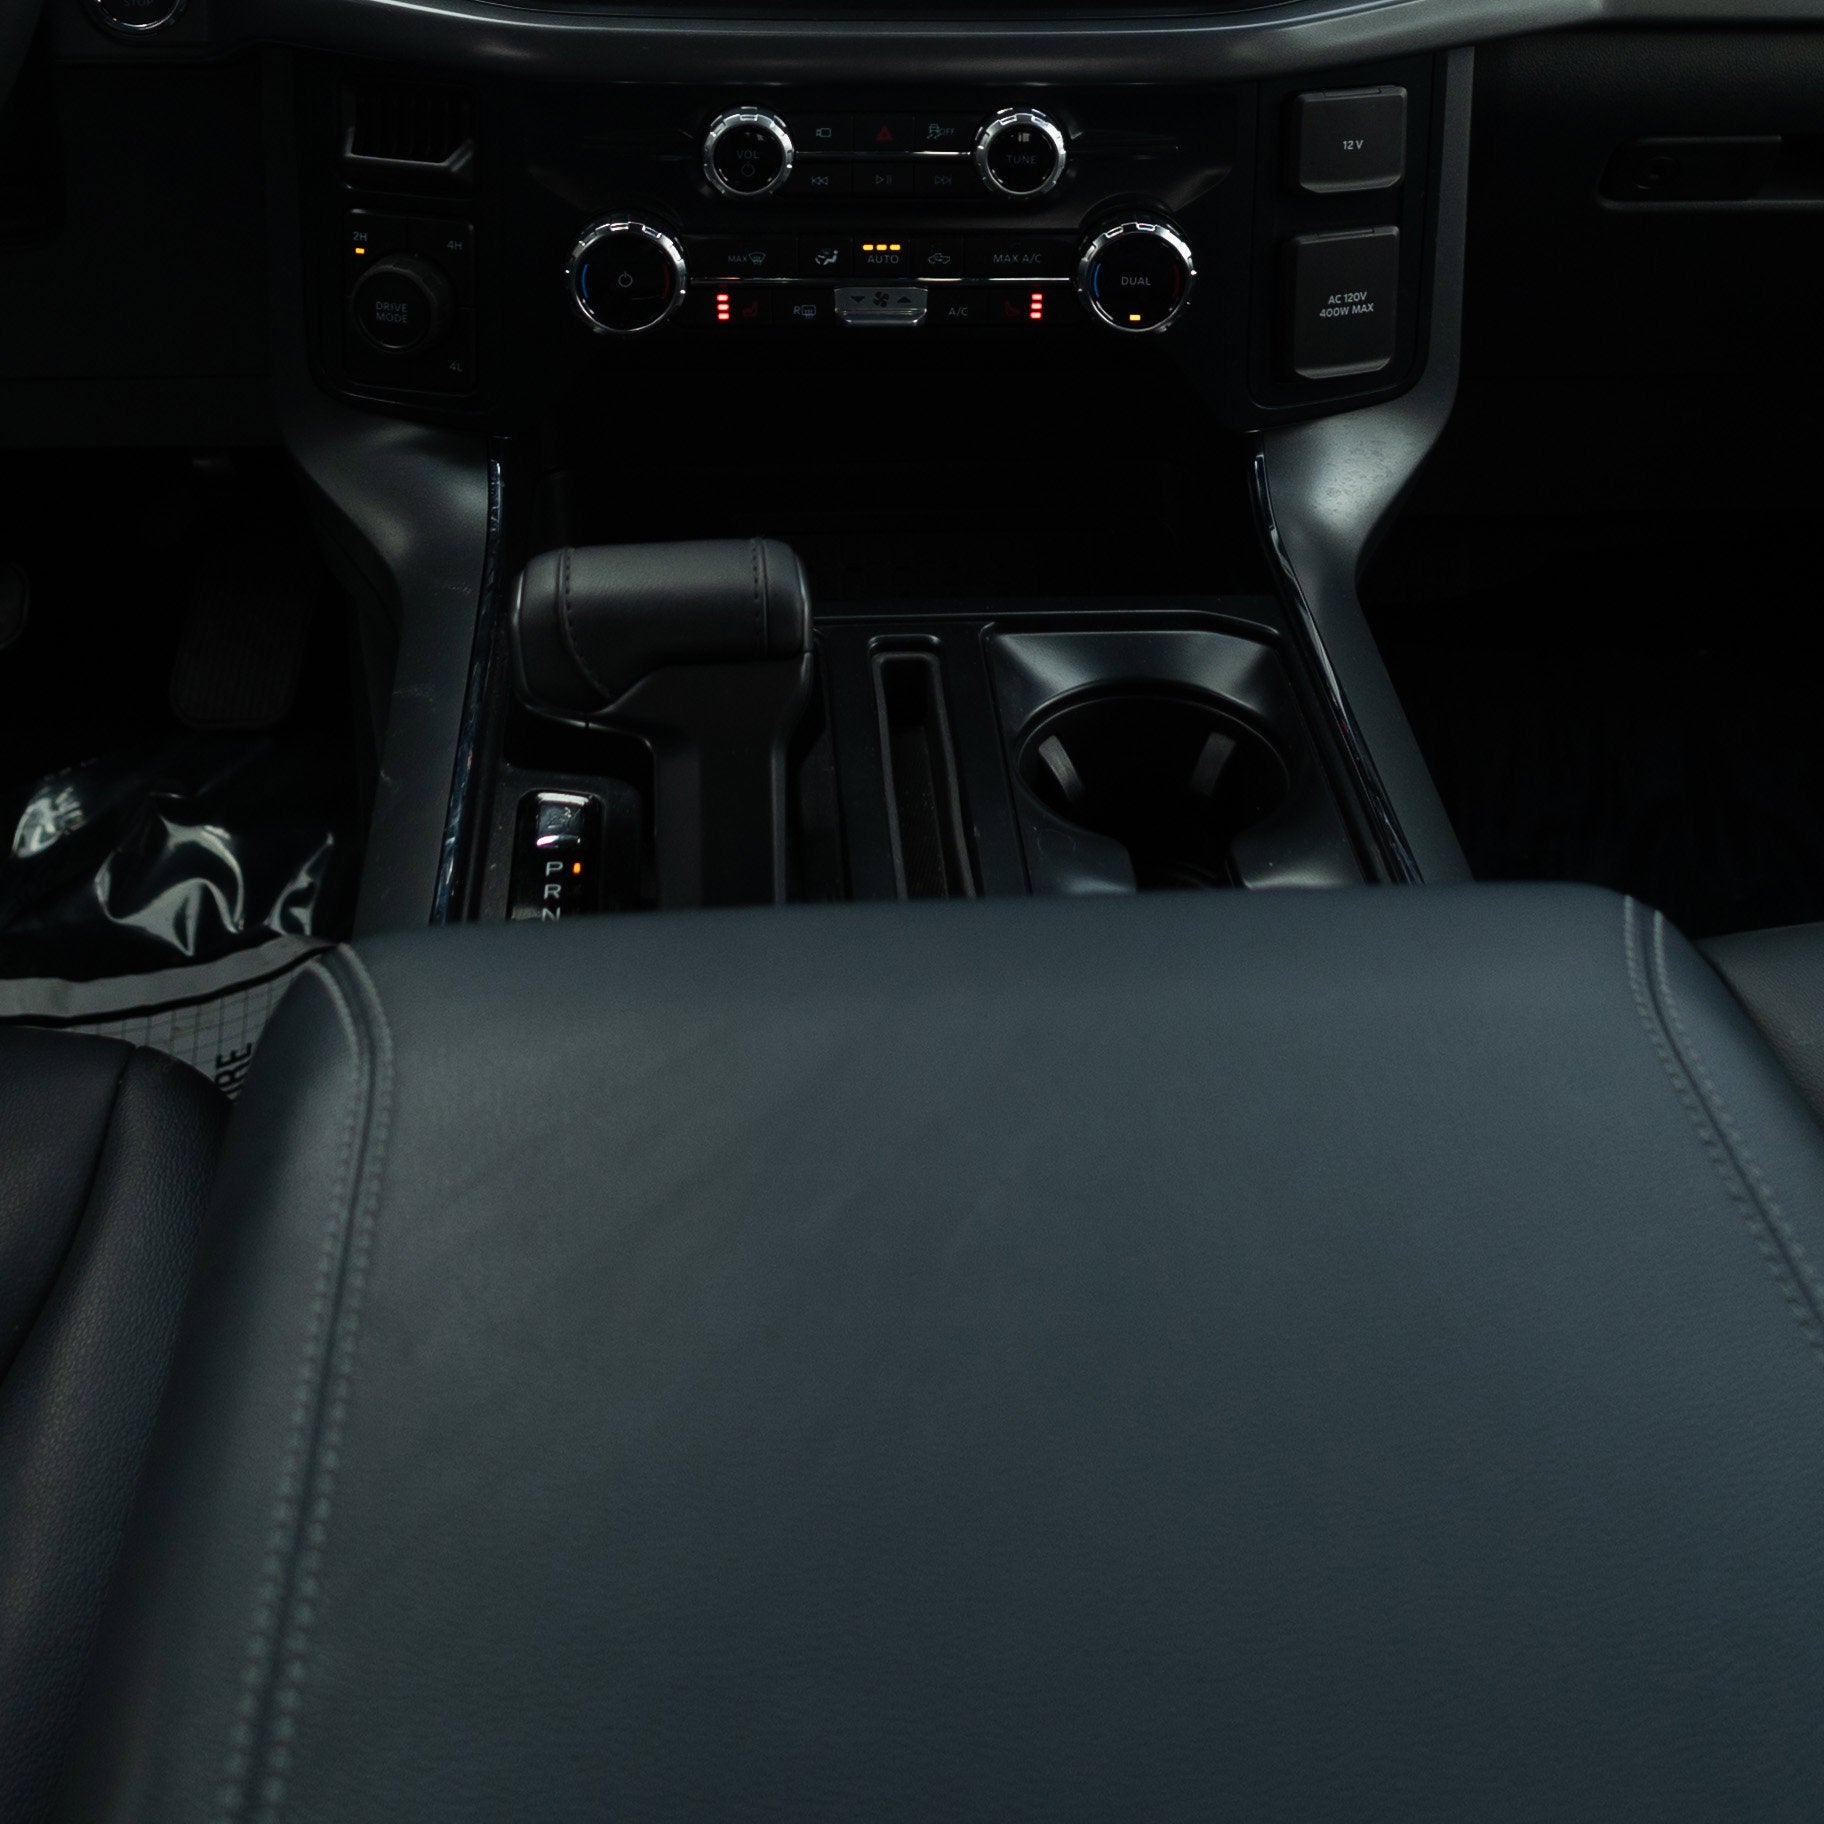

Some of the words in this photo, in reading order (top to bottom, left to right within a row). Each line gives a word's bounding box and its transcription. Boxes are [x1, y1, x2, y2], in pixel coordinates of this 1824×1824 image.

[1342, 140, 1355, 151] 12
[1356, 140, 1364, 151] V
[735, 149, 760, 161] VOL
[1007, 155, 1039, 166] TUNE
[352, 231, 368, 242] 2H
[446, 240, 463, 251] 4H
[727, 254, 748, 264] MAX
[867, 254, 900, 265] AUTO
[993, 253, 1019, 264] MAX
[1021, 253, 1042, 264] A/C
[1121, 276, 1152, 287] DUAL
[1327, 294, 1341, 306] AC
[1343, 292, 1368, 305] 120V
[375, 301, 408, 312] DRIVE
[948, 306, 969, 317] A/C
[1319, 306, 1346, 319] 400W
[1348, 304, 1374, 316] MAX
[375, 312, 409, 325] MODE
[449, 362, 463, 372] 4L
[545, 861, 564, 877] P
[543, 883, 562, 900] R
